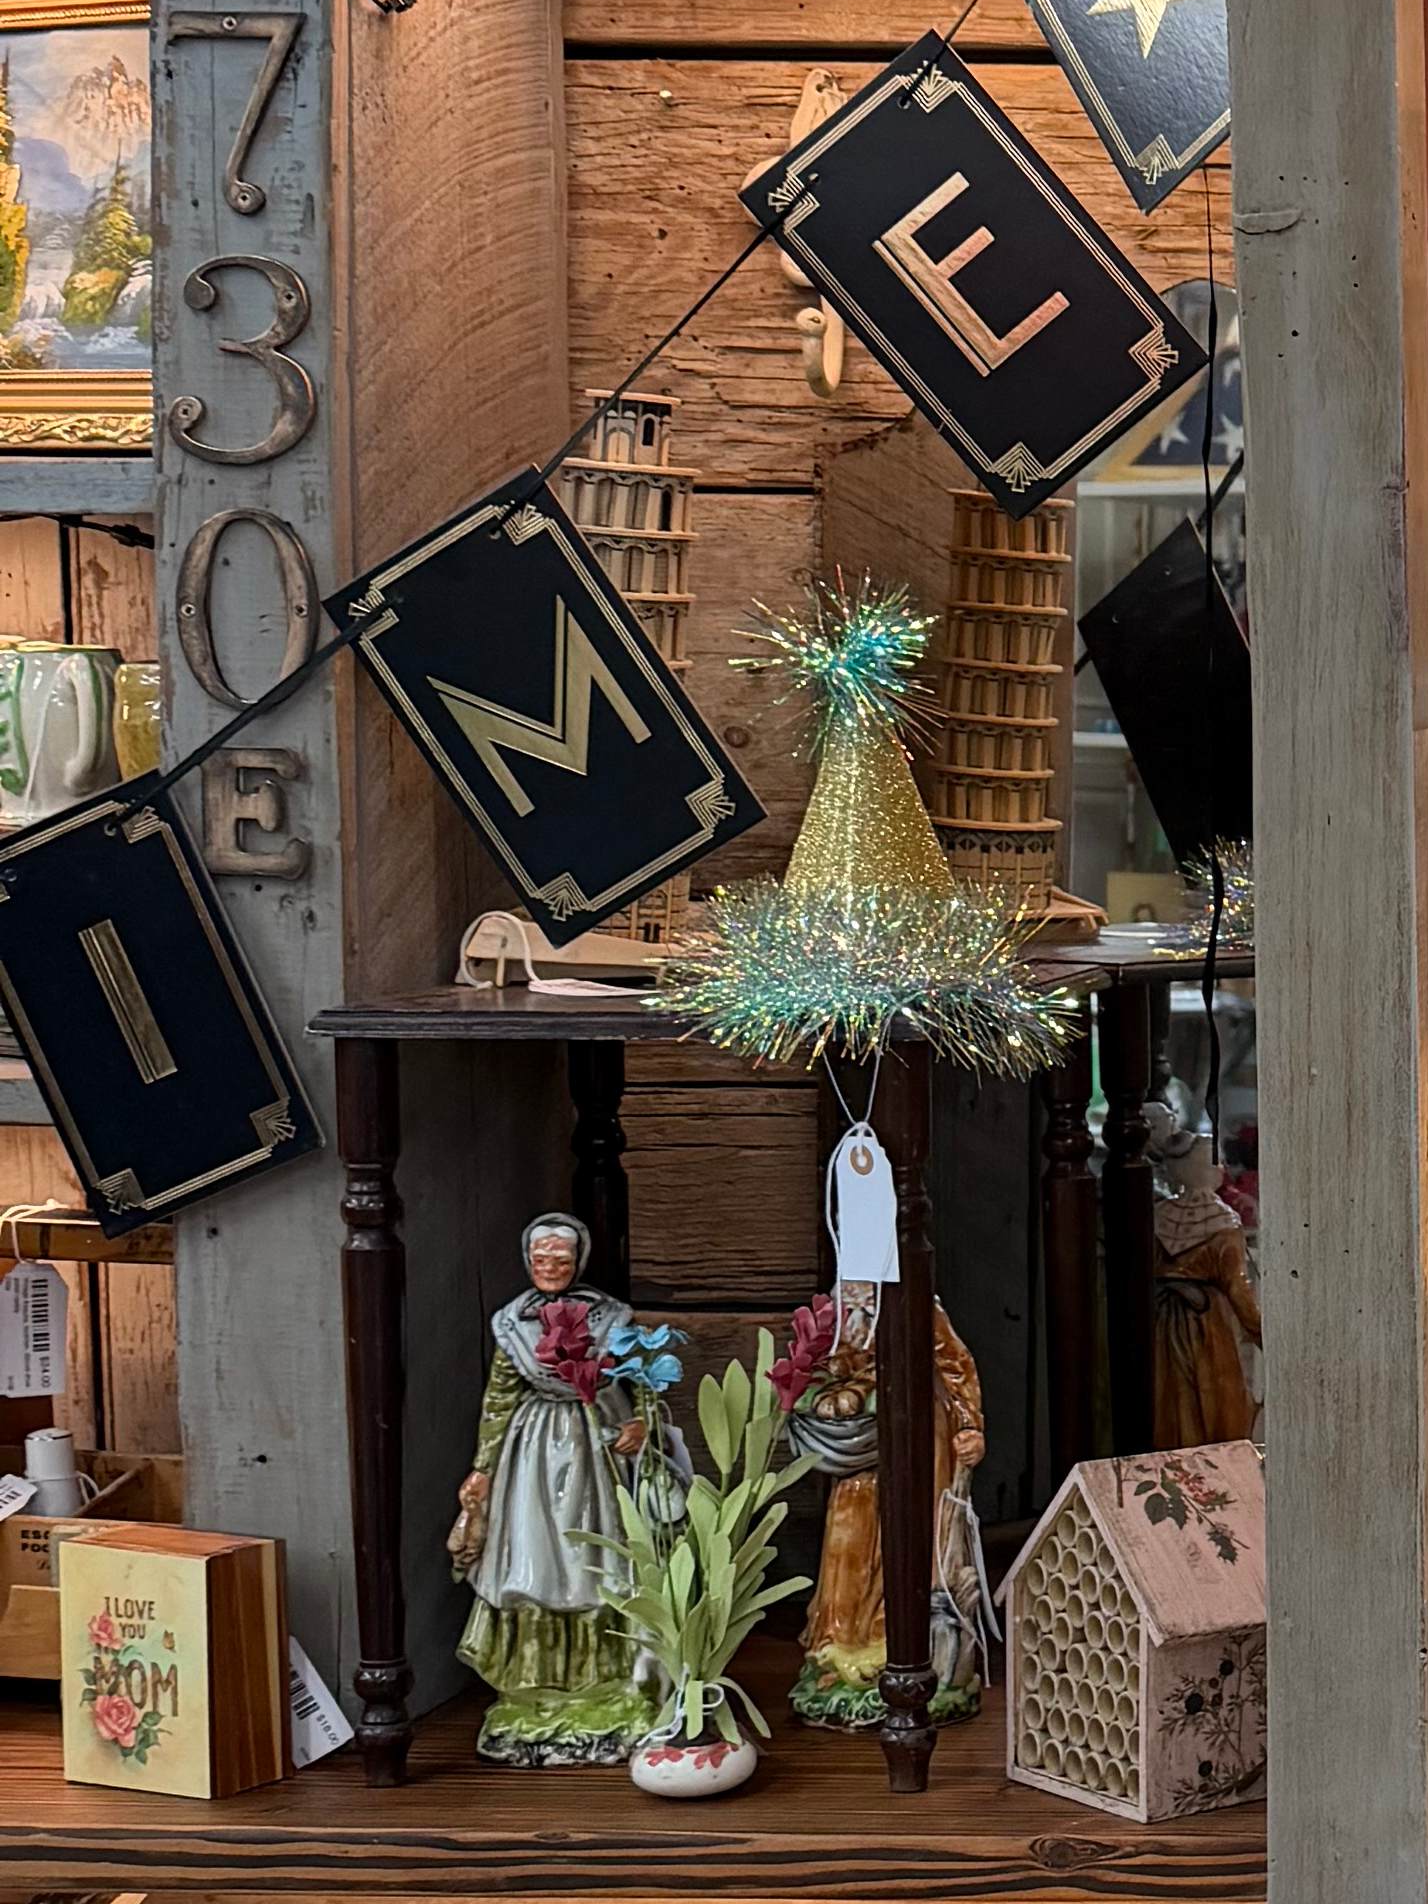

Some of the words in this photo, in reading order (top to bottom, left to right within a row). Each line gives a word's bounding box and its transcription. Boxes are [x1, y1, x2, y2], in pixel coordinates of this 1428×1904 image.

[104, 1596, 112, 1617] I
[114, 1597, 156, 1621] LOVE
[119, 1622, 146, 1639] YOU
[93, 1655, 178, 1717] MOM
